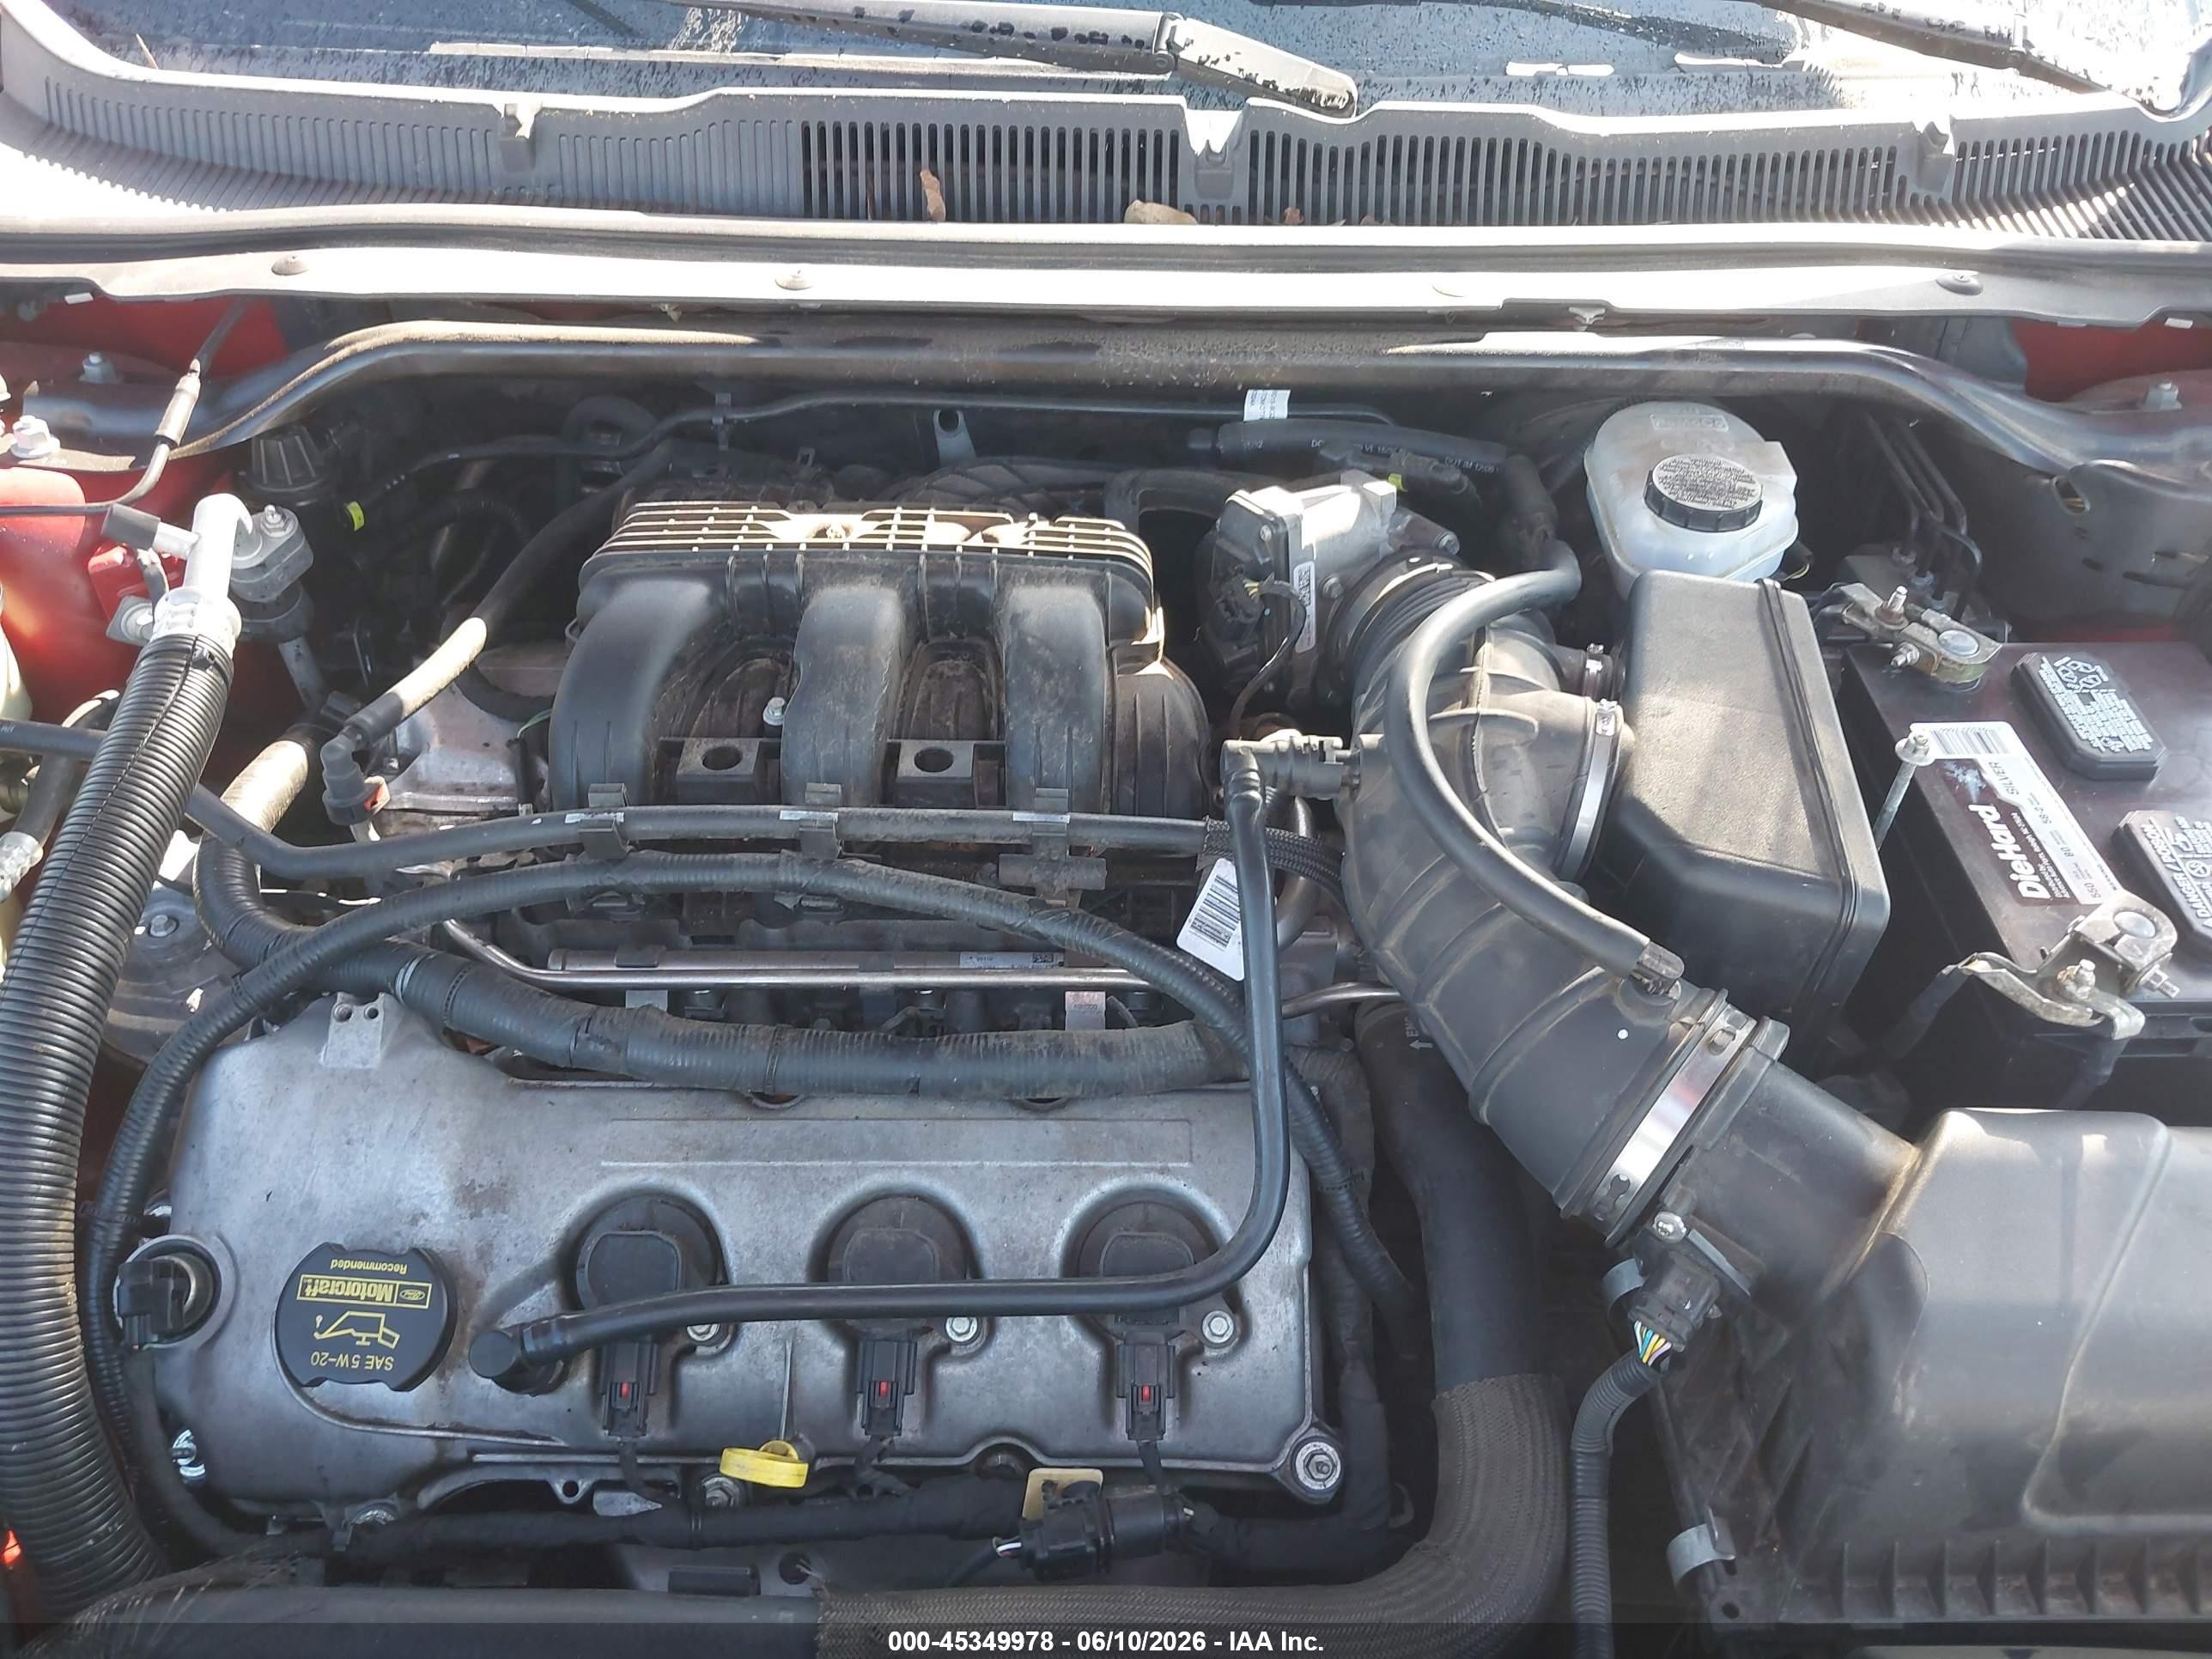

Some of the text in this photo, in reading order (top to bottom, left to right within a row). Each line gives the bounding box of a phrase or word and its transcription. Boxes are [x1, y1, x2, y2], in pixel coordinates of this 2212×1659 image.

[1989, 762, 2019, 795] SILVER
[1968, 804, 2051, 899] DieHard
[2142, 824, 2178, 863] POISON
[2084, 882, 2101, 898] 550
[2172, 872, 2212, 919] DANGER
[330, 1259, 408, 1275] Recommended
[304, 1278, 395, 1303] Motorcraft
[364, 1355, 394, 1371] SAE
